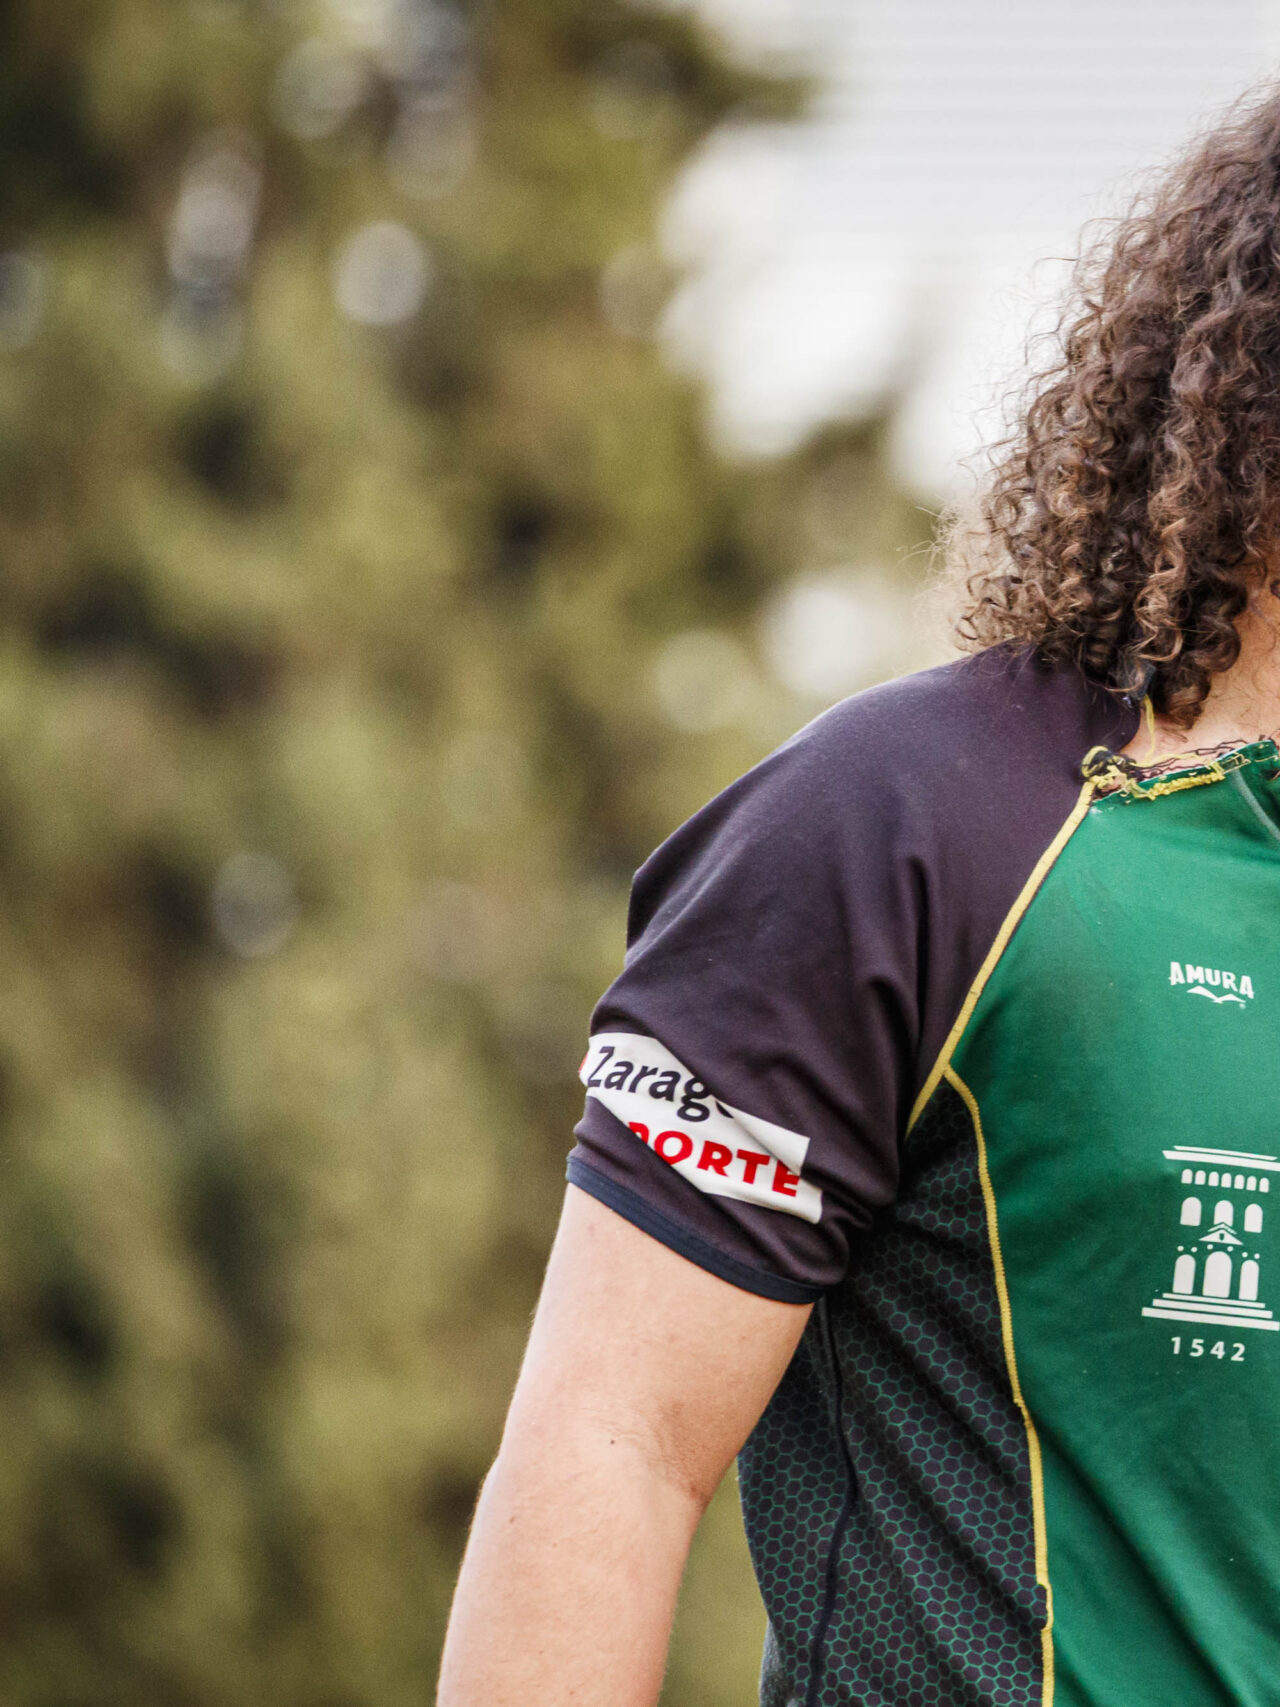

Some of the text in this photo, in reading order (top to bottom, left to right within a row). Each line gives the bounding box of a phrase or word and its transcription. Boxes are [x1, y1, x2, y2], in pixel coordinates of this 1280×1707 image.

[1168, 961, 1255, 999] AMURA
[588, 1046, 735, 1122] Zarag
[1170, 1336, 1247, 1362] 1542
